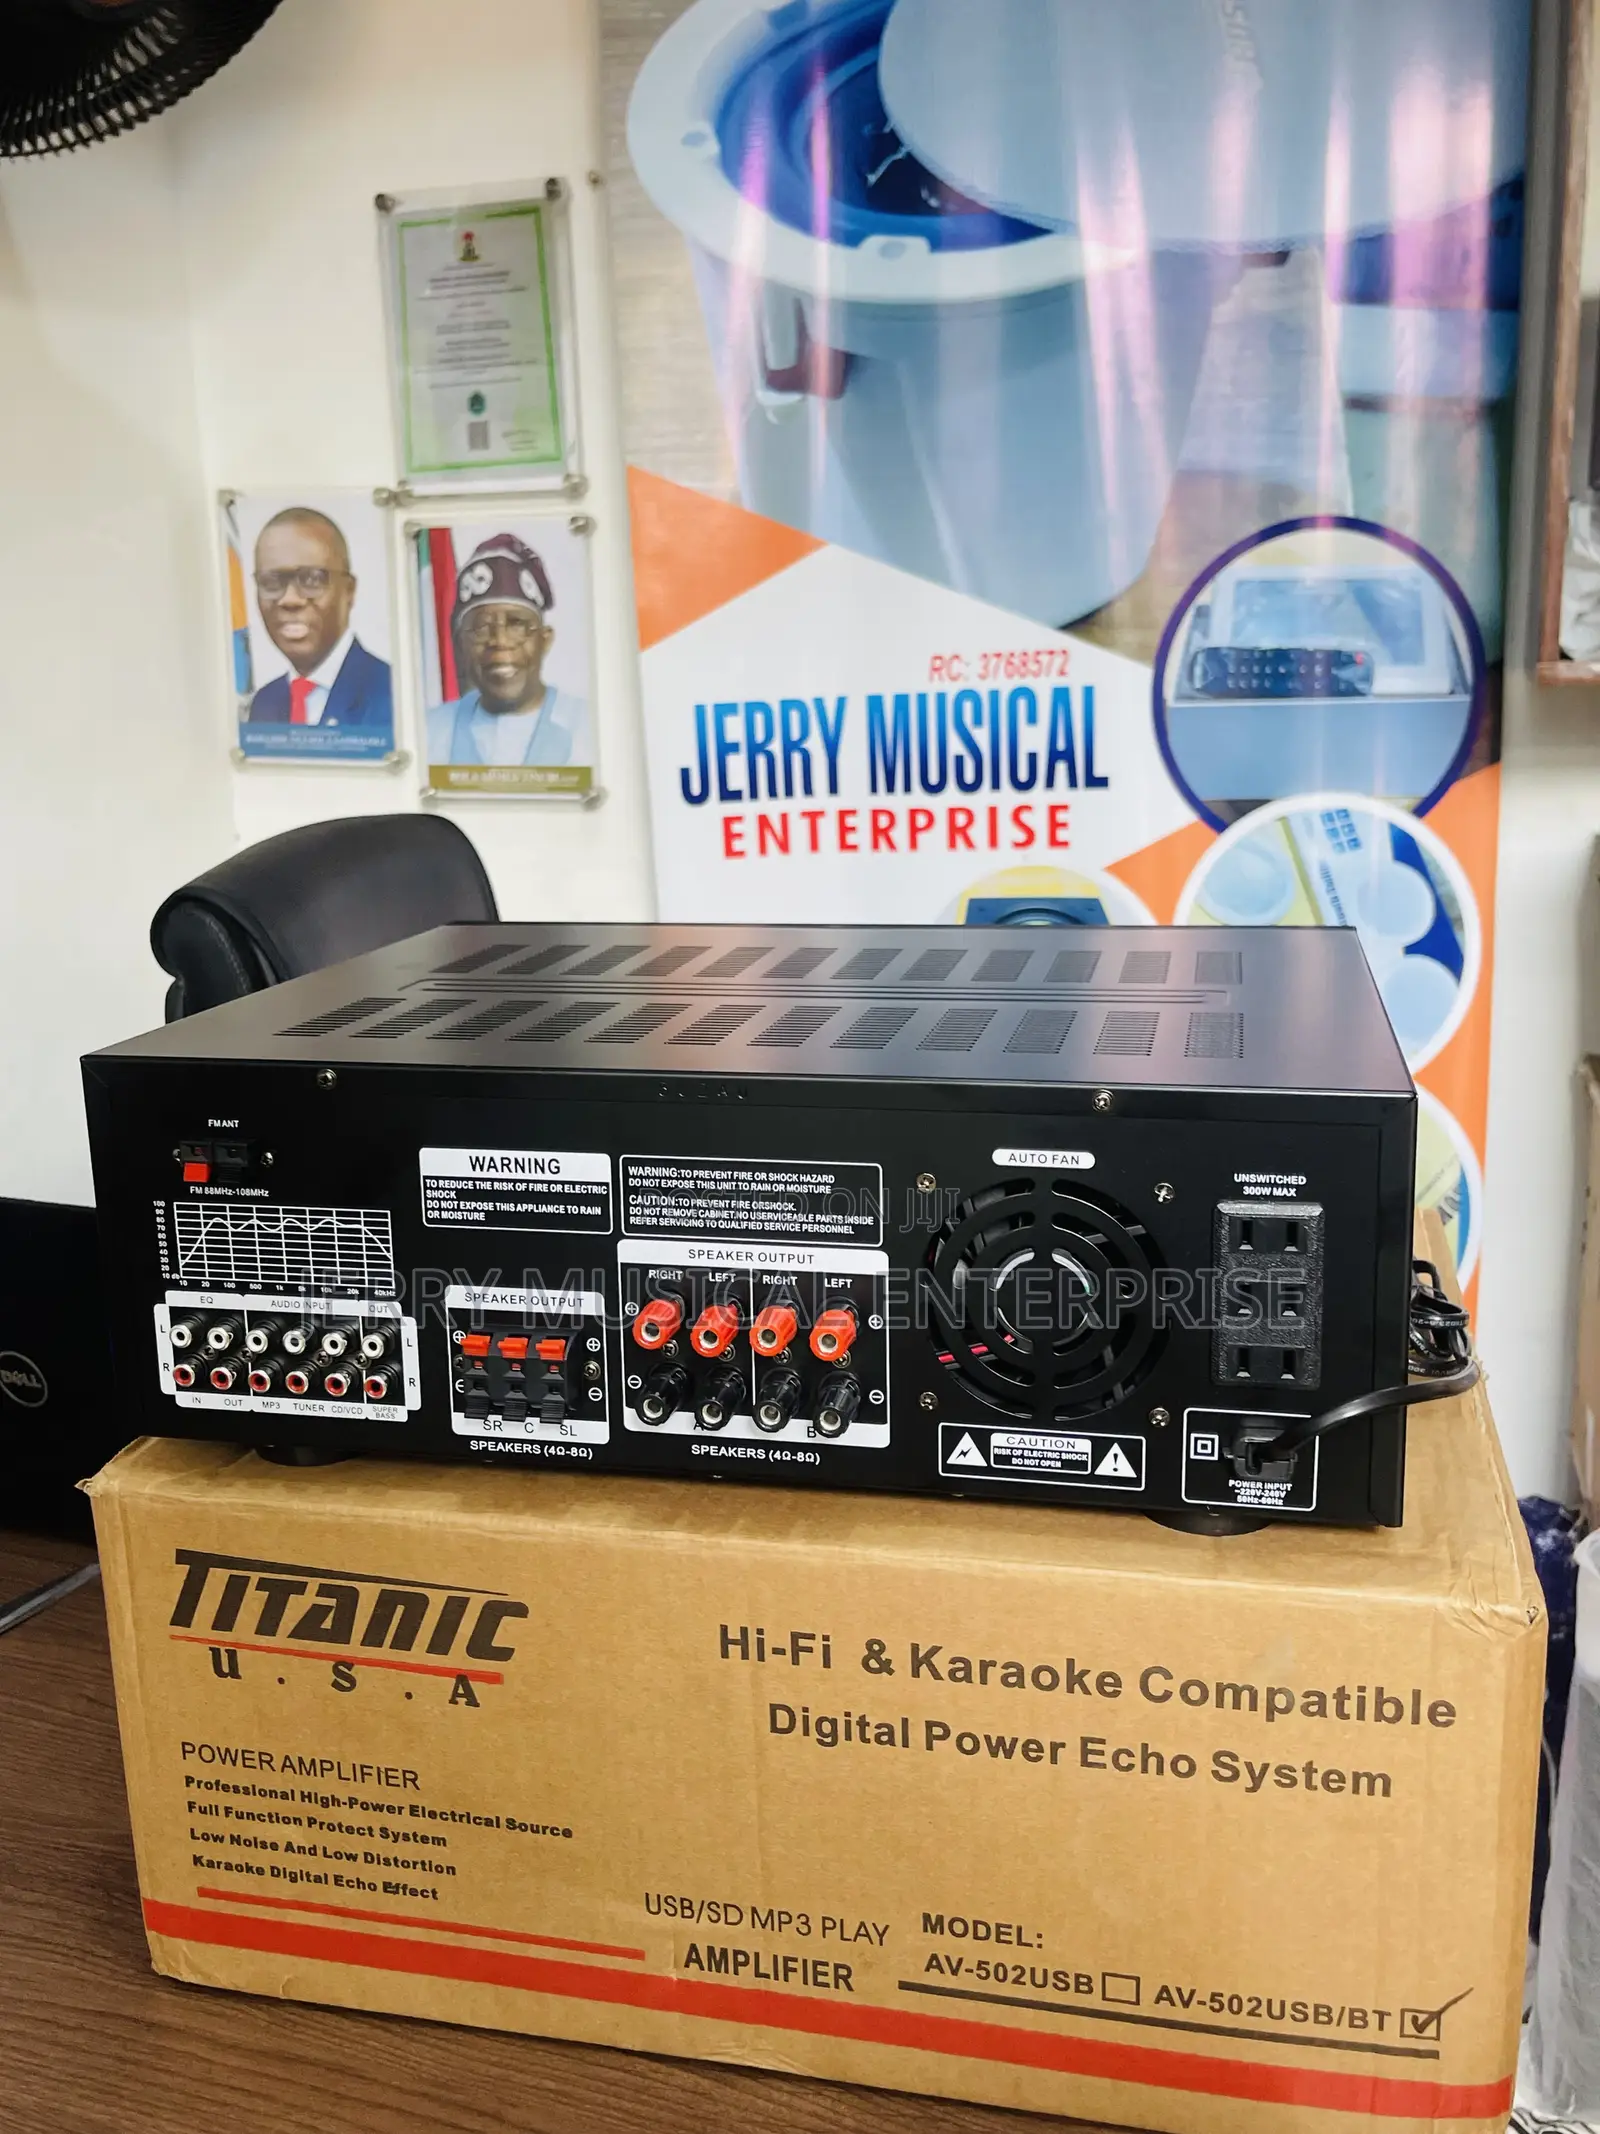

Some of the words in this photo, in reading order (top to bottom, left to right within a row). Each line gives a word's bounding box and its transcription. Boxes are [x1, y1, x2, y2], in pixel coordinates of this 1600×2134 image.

[929, 654, 970, 682] RC:
[977, 649, 1070, 679] 3768572
[680, 697, 847, 806] JERRY
[867, 686, 1109, 794] MUSICAL
[722, 804, 1071, 859] ENTERPRISE
[469, 1155, 561, 1174] WARNING
[1008, 1153, 1047, 1164] AUTO
[1052, 1154, 1080, 1166] FAN
[693, 1170, 732, 1180] PREVENT
[734, 1171, 752, 1180] FIRE
[754, 1172, 767, 1181] OR
[769, 1173, 799, 1182] SHOCK
[800, 1174, 835, 1183] HAZARD
[1234, 1174, 1307, 1185] UNSWITCHED
[425, 1179, 438, 1188] TO
[438, 1180, 474, 1190] REDUCE
[475, 1181, 492, 1190] THE
[493, 1182, 514, 1191] RISK
[515, 1182, 527, 1192] OF
[529, 1183, 548, 1192] FIRE
[550, 1184, 563, 1193] OR
[564, 1185, 608, 1195] ELECTRIC
[629, 1178, 641, 1186] DO
[642, 1178, 660, 1187] NOT
[661, 1179, 695, 1188] EXPOSE
[696, 1180, 715, 1189] THIS
[717, 1181, 736, 1190] UNIT
[738, 1182, 750, 1190] TO
[751, 1182, 771, 1191] RAIN
[773, 1184, 785, 1192] OR
[786, 1184, 832, 1194] MOISTURE
[1243, 1186, 1271, 1196] 300W
[1272, 1187, 1297, 1197] MAX
[426, 1190, 456, 1199] SHOCK
[427, 1200, 439, 1209] DO
[441, 1201, 458, 1210] NOT
[460, 1202, 494, 1211] EXPOSE
[496, 1203, 515, 1212] THIS
[516, 1204, 565, 1214] APPLIANCE
[567, 1206, 579, 1214] TO
[580, 1206, 602, 1215] RAIN
[691, 1199, 730, 1208] PREVENT
[731, 1200, 750, 1209] FIRE
[427, 1210, 440, 1219] OR
[441, 1211, 486, 1221] MOISTURE
[630, 1207, 641, 1215] DO
[643, 1207, 661, 1216] NOT
[662, 1208, 698, 1218] REMOVE
[816, 1214, 844, 1224] PARTS
[844, 1216, 874, 1225] INSIDE
[630, 1216, 658, 1225] REFER
[659, 1218, 704, 1227] SERVICING
[705, 1220, 717, 1228] TO
[718, 1220, 762, 1230] QUALIFIED
[764, 1222, 801, 1231] SERVICE
[802, 1224, 854, 1234] PERSONNEL
[688, 1249, 754, 1262] SPEAKER
[758, 1252, 815, 1265] OUTPUT
[648, 1269, 683, 1281] RIGHT
[708, 1272, 737, 1283] LEFT
[762, 1275, 798, 1286] RIGHT
[824, 1278, 853, 1289] LEFT
[200, 1296, 214, 1304] EQ
[271, 1300, 300, 1309] AUDIO
[303, 1301, 332, 1310] INPUT
[464, 1292, 527, 1305] SPEAKER
[530, 1295, 584, 1308] OUTPUT
[369, 1304, 388, 1314] OUT
[192, 1396, 201, 1404] IN
[224, 1398, 243, 1407] OUT
[262, 1401, 281, 1410] MP3
[293, 1403, 325, 1412] TUNER
[332, 1406, 363, 1414] CD/VCD
[373, 1406, 398, 1414] SUPER
[376, 1412, 396, 1420] BASS
[483, 1420, 503, 1432] SR
[524, 1422, 534, 1434] C
[560, 1424, 578, 1437] SL
[470, 1440, 541, 1454] SPEAKERS
[1006, 1436, 1076, 1449] CAUTION
[691, 1444, 766, 1459] SPEAKERS
[994, 1448, 1012, 1456] RISK
[1024, 1450, 1060, 1459] ELECTRIC
[1061, 1452, 1088, 1461] SHOCK
[1040, 1460, 1062, 1468] OPEN
[1229, 1480, 1263, 1489] POWER
[1264, 1482, 1292, 1491] INPUT
[719, 1624, 833, 1670] Hi-Fi
[861, 1638, 895, 1677] &
[910, 1642, 1123, 1699] Karaoke
[1139, 1666, 1457, 1728] Compatible
[769, 1703, 910, 1749] Digital
[925, 1722, 1067, 1765] Power
[1080, 1738, 1197, 1780] Echo
[1210, 1752, 1392, 1799] System
[181, 1741, 276, 1772] POWER
[280, 1754, 421, 1791] AMPLIFIER
[185, 1776, 296, 1802] Professional
[301, 1790, 405, 1817] High-Power
[409, 1804, 501, 1829] Electrical
[505, 1817, 574, 1839] Source
[187, 1801, 220, 1818] Full
[224, 1806, 303, 1827] Function
[307, 1816, 375, 1838] Protect
[379, 1827, 448, 1849] System
[190, 1828, 225, 1844] Low
[230, 1833, 280, 1852] Noise
[284, 1839, 318, 1857] And
[322, 1846, 359, 1864] Low
[364, 1851, 457, 1876] Distortion
[192, 1854, 266, 1877] Karaoke
[270, 1865, 330, 1888] Digital
[334, 1873, 378, 1892] Echo
[382, 1881, 439, 1900] Effect
[644, 1892, 744, 1930] USB/SD
[750, 1906, 813, 1938] MP3
[820, 1914, 890, 1947] PLAY
[922, 1912, 1044, 1950] MODEL:
[683, 1944, 855, 1992] AMPLIFIER
[924, 1954, 1094, 1995] AV-502USB
[1154, 1985, 1391, 2033] AV-502USB/BT
